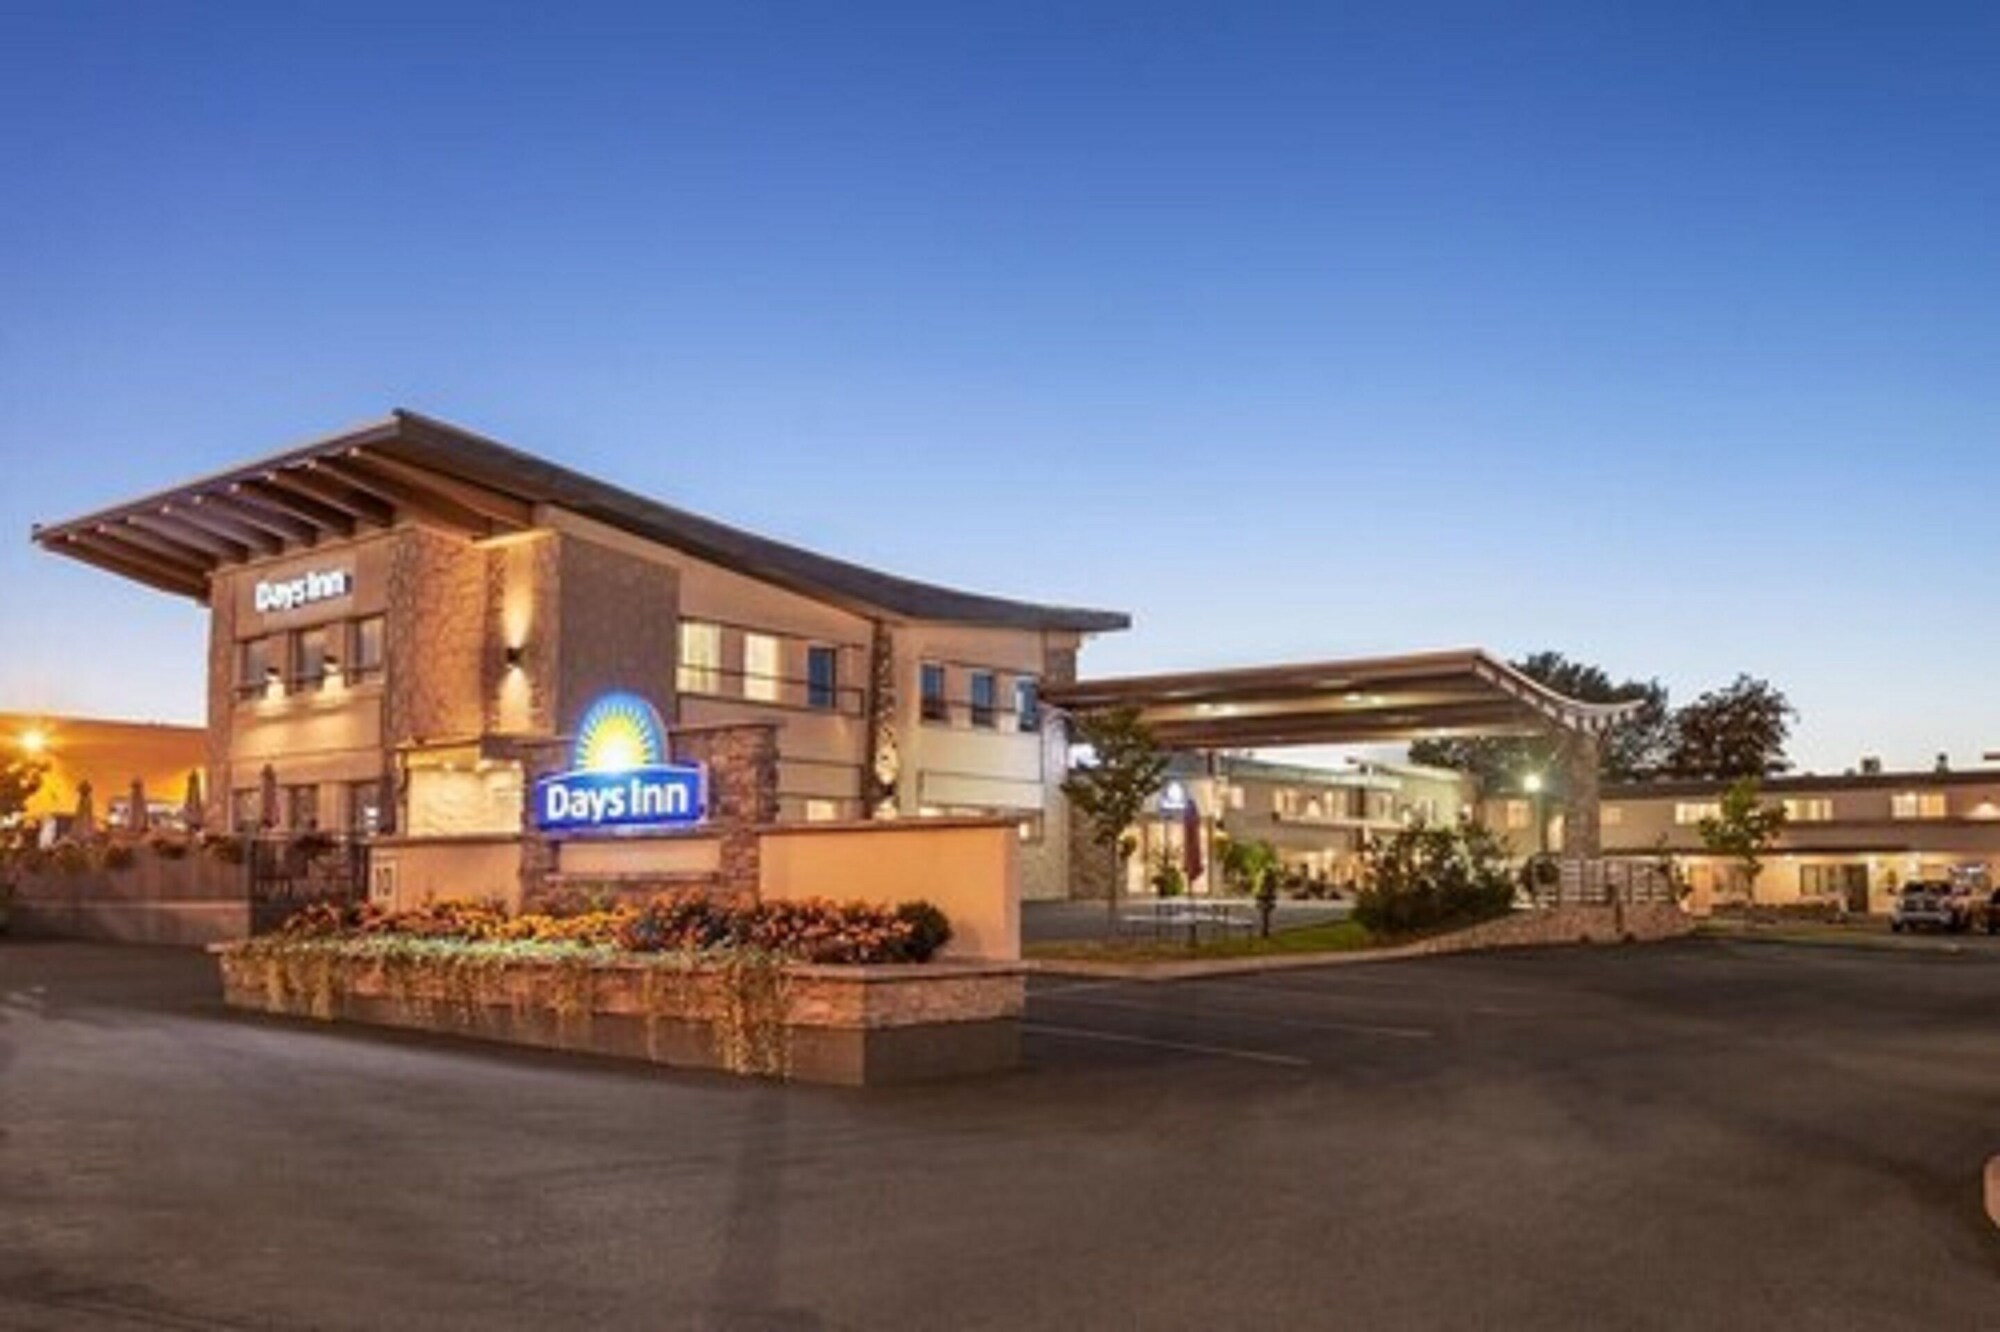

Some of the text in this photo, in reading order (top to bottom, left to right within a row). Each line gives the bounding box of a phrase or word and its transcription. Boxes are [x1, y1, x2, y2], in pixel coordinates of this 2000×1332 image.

[256, 579, 305, 611] Days
[547, 778, 688, 822] Days Inn
